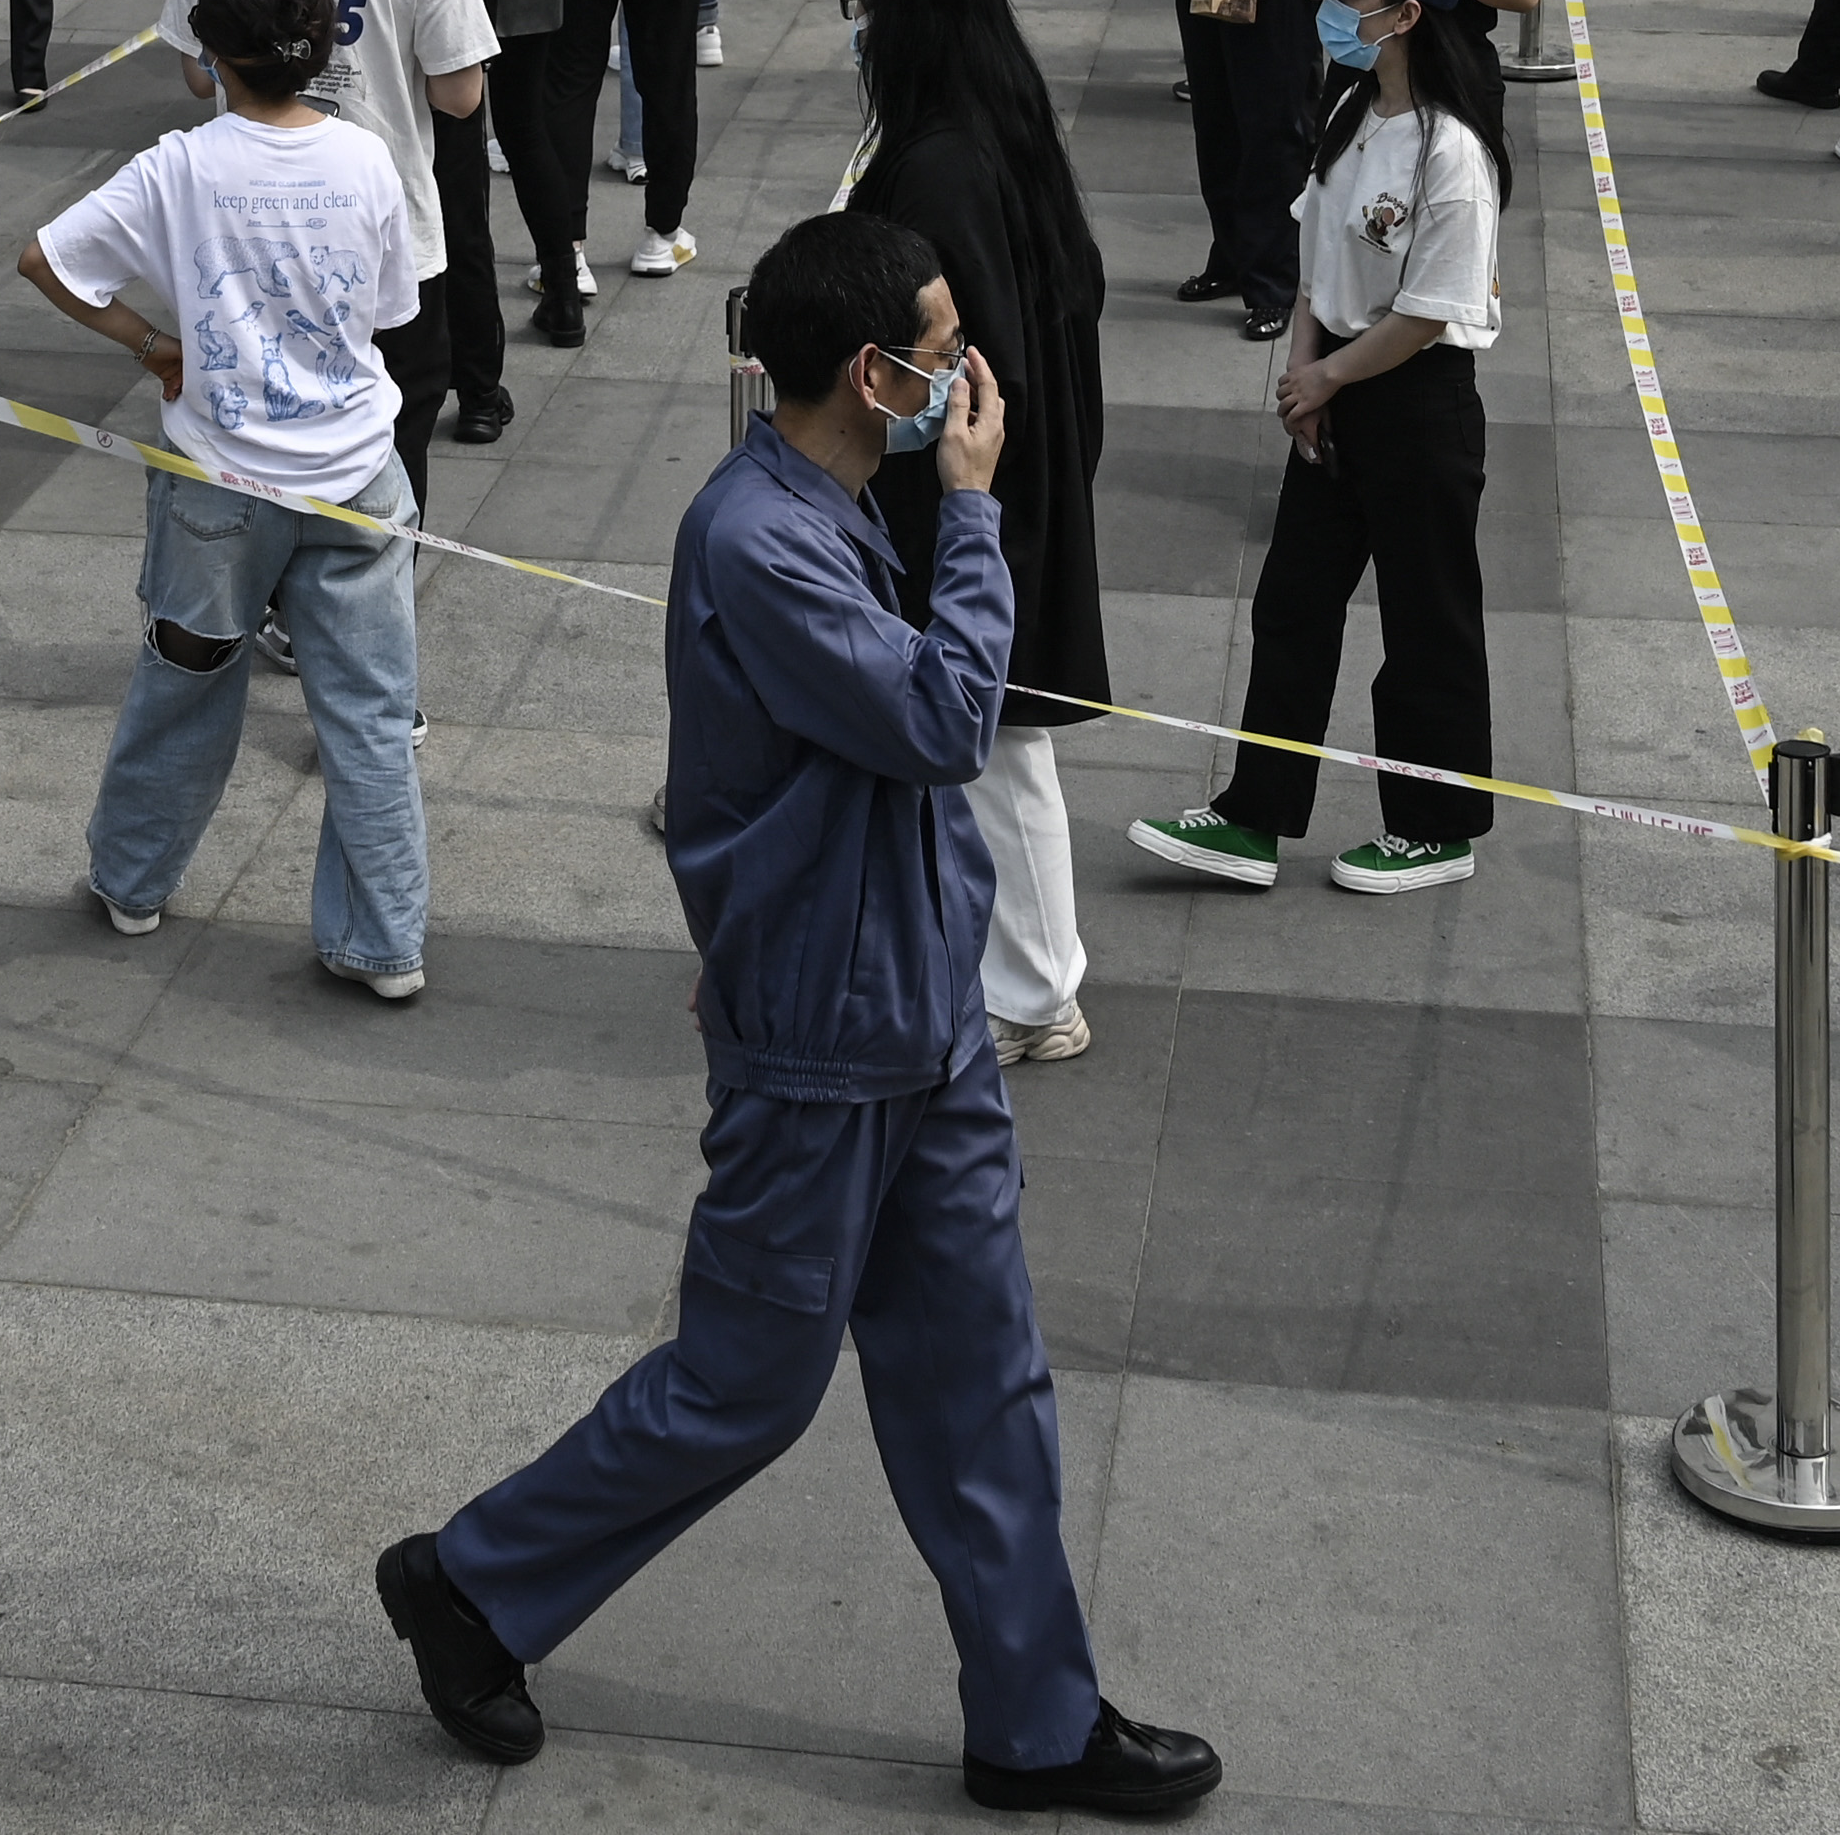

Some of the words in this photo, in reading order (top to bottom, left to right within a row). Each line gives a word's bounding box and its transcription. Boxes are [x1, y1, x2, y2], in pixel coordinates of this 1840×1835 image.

[213, 190, 248, 214] keep
[251, 193, 290, 214] green
[292, 192, 320, 211] and
[323, 191, 358, 209] clean
